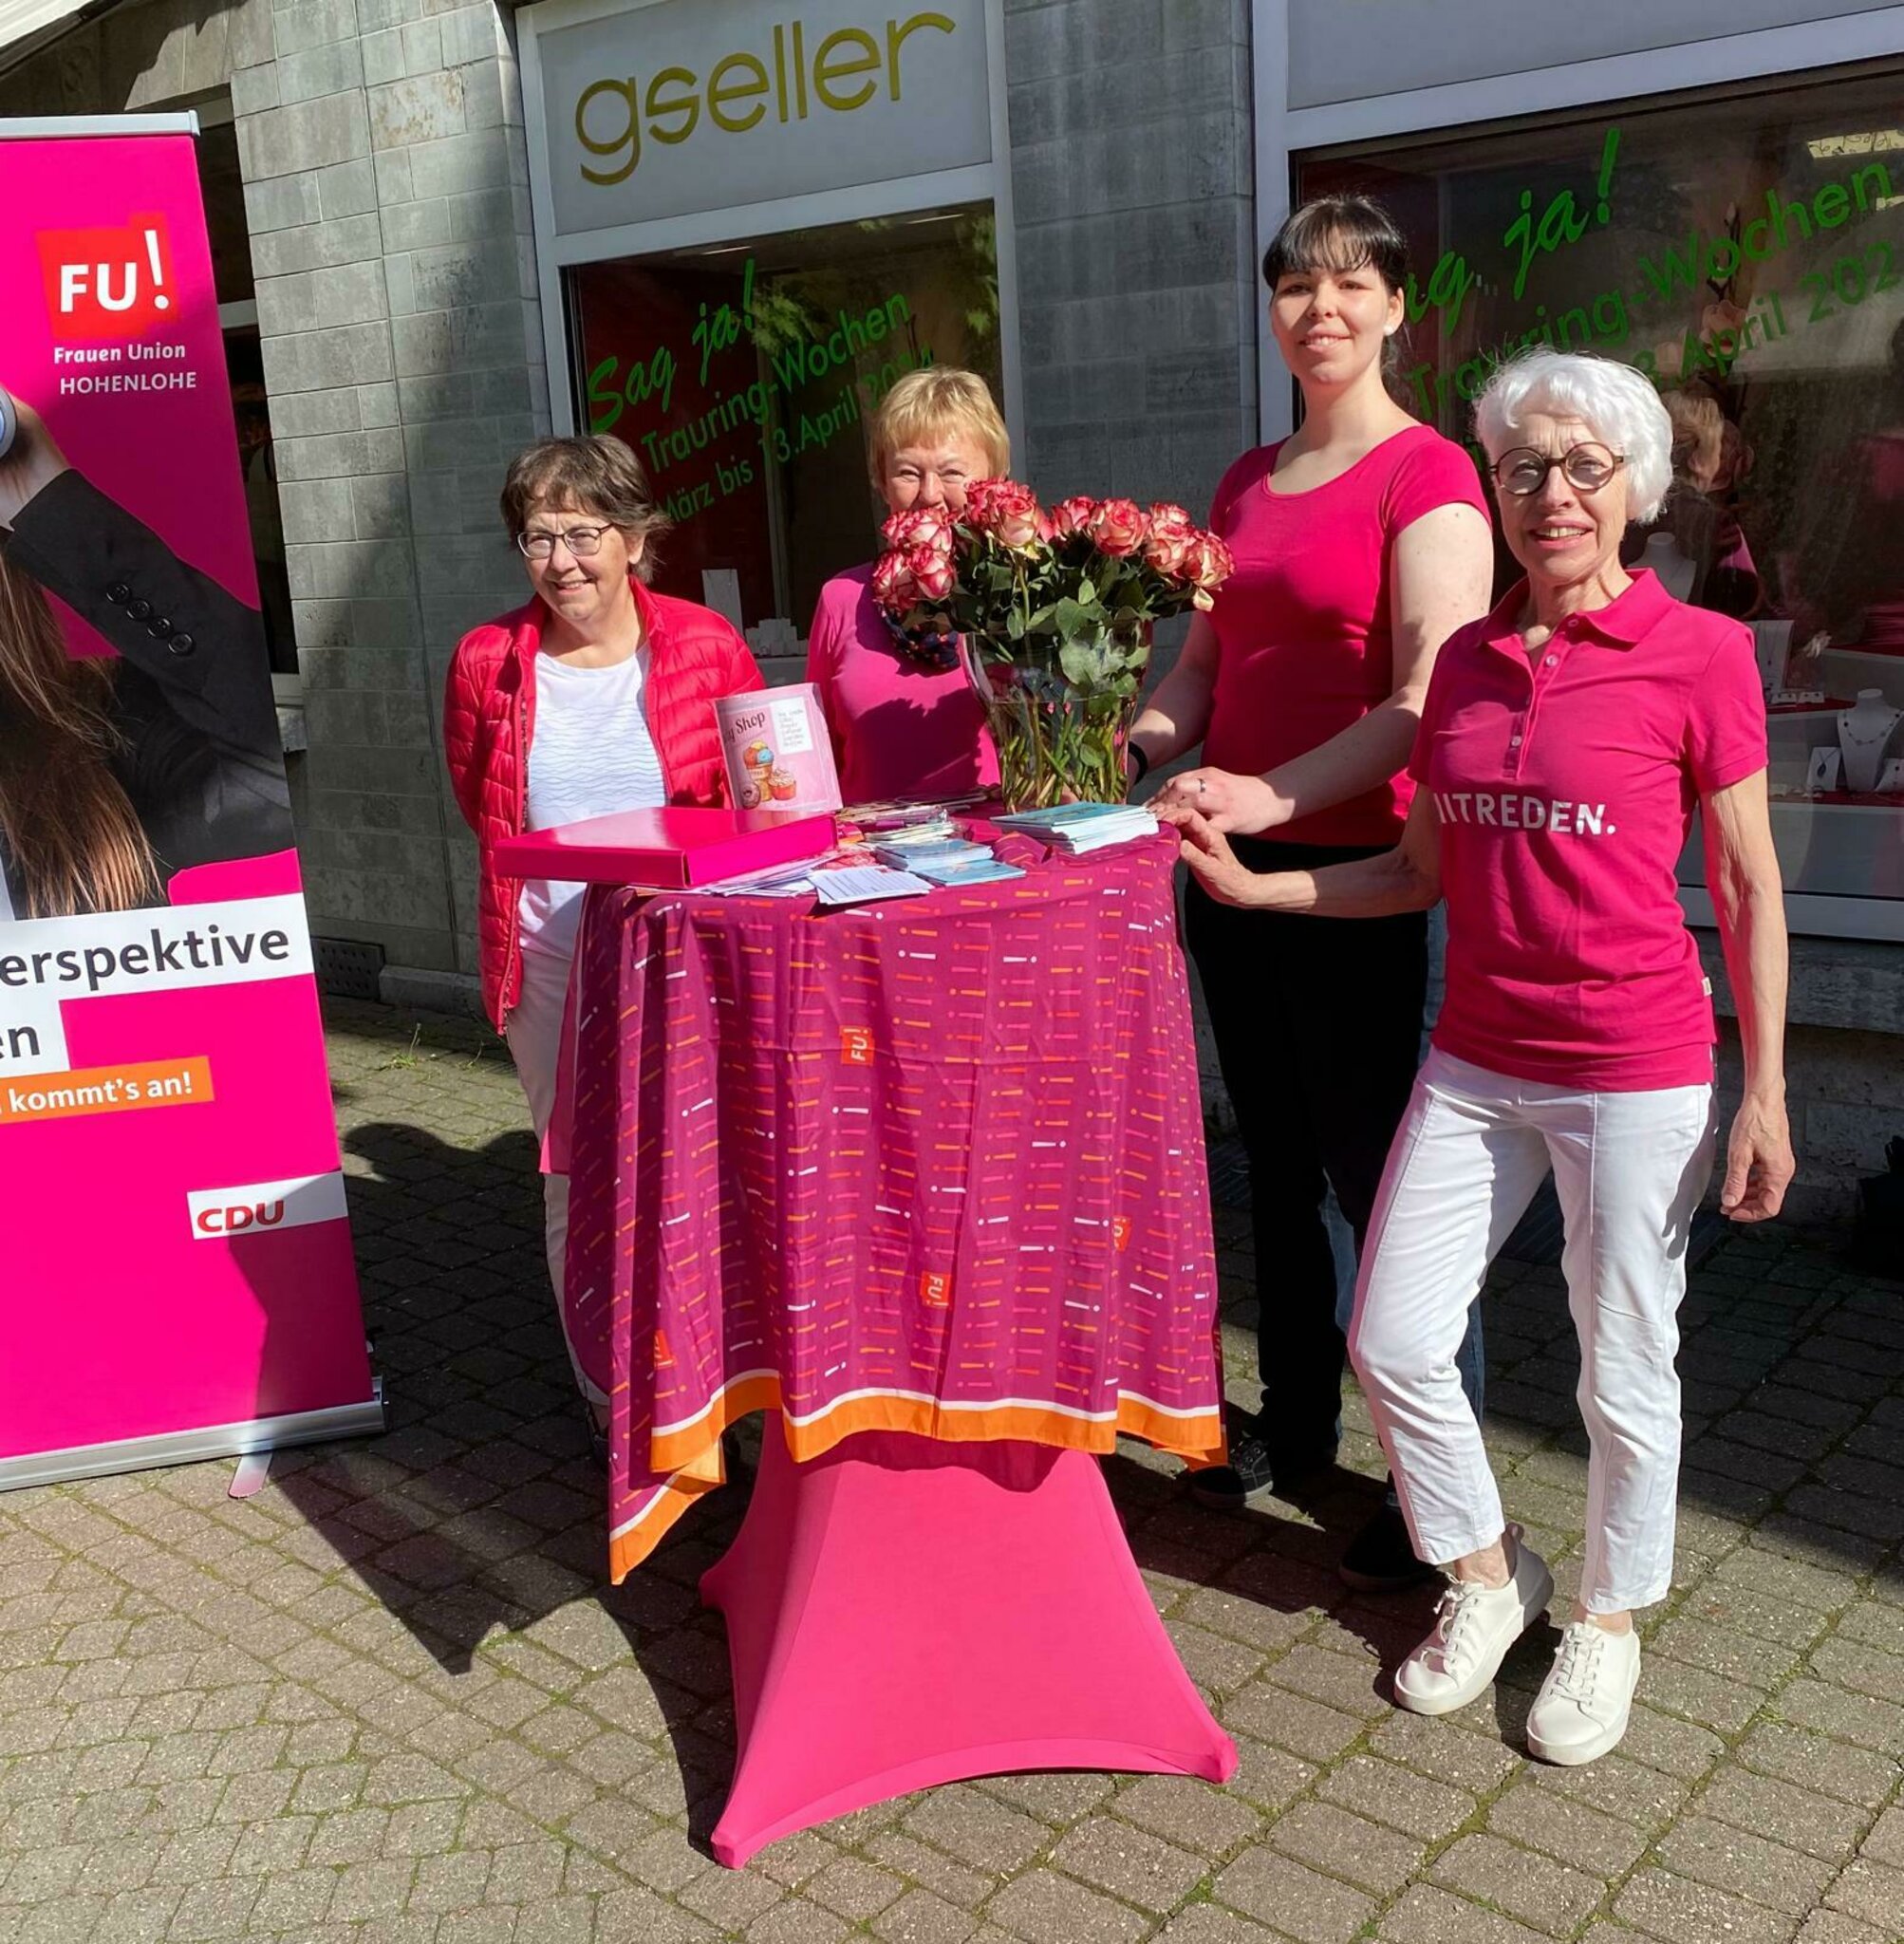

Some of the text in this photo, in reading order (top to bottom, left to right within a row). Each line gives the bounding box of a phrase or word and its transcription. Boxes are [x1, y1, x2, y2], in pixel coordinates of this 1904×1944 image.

[575, 12, 956, 185] gseller
[1503, 127, 1621, 300] ja!
[60, 230, 170, 312] FU!
[54, 342, 186, 364] Frauen Union
[588, 257, 756, 435] Sag ja!
[60, 371, 196, 396] HOHENLOHE
[641, 292, 910, 474] Trauring-Wochen
[715, 454, 755, 496] bis
[735, 711, 766, 735] Shop
[843, 1028, 868, 1062] FU!
[146, 1071, 193, 1098] an!
[196, 1200, 285, 1233] CDU
[927, 1274, 949, 1307] FU!
